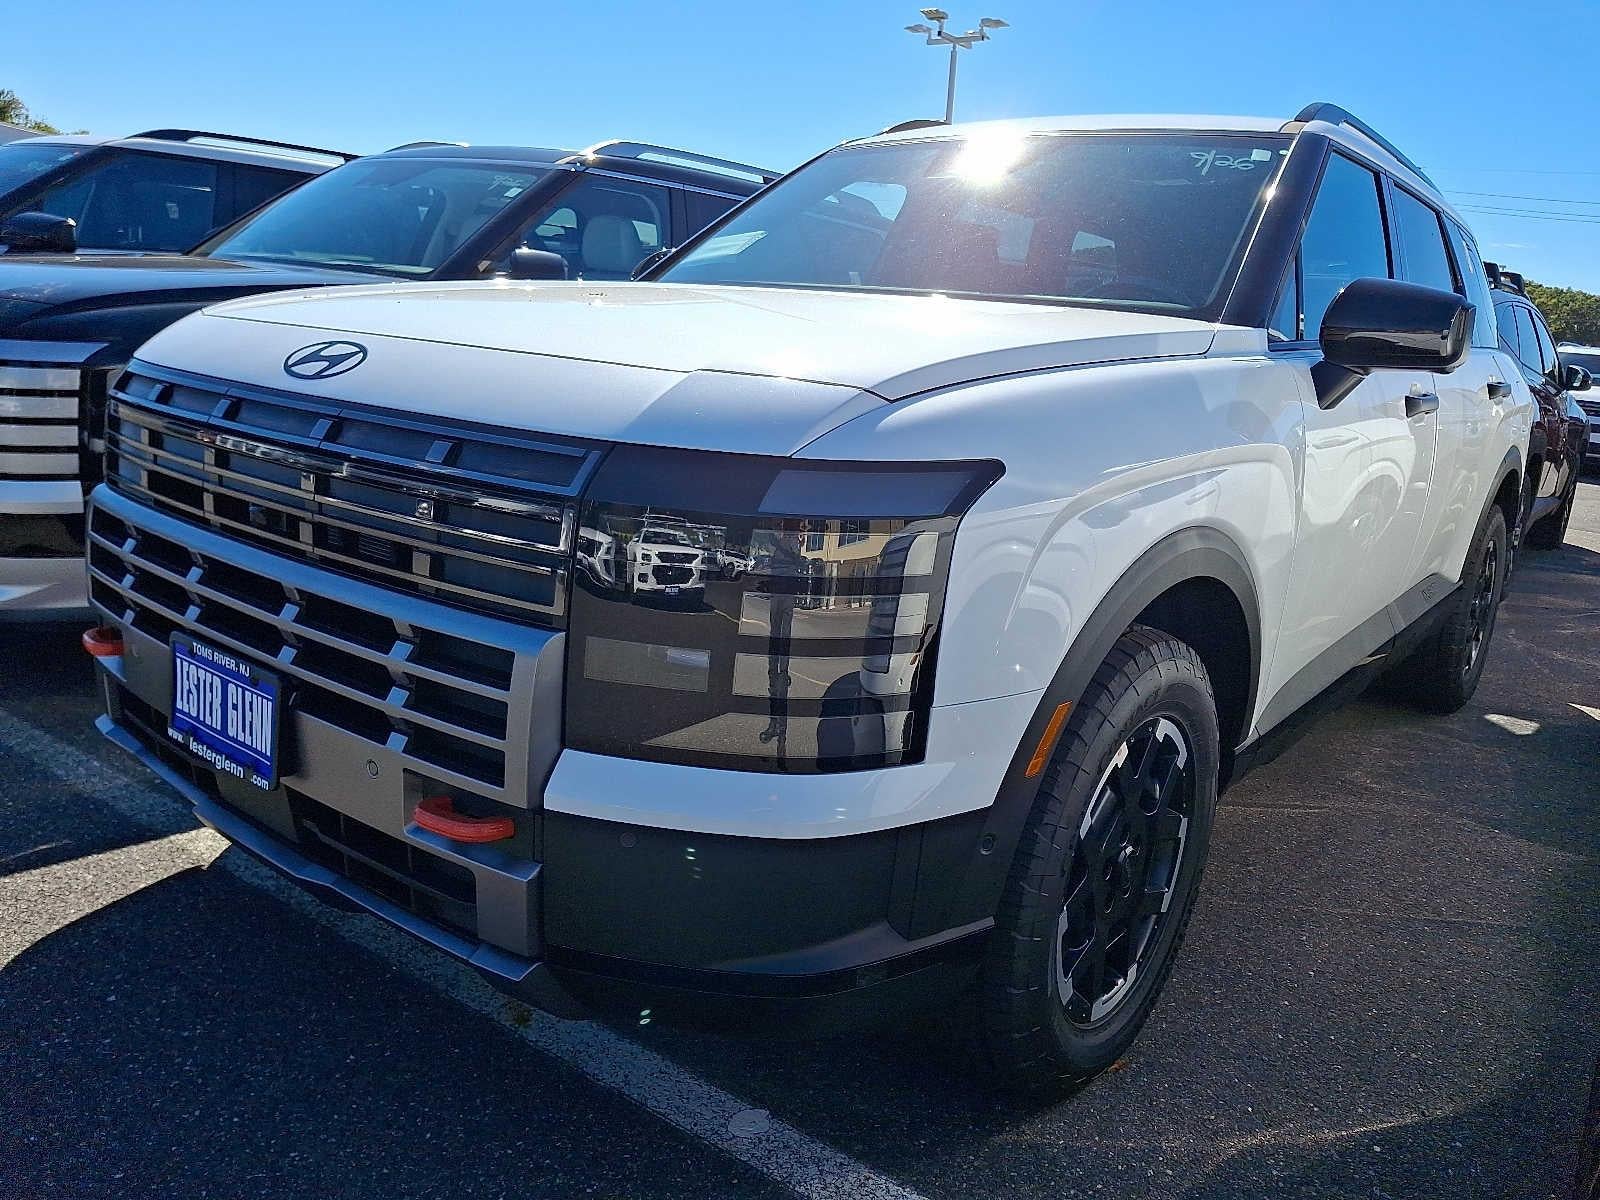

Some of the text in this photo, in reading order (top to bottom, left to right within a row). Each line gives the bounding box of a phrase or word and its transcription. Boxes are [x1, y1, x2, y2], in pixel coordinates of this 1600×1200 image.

[192, 641, 250, 677] TOMS RIVER, NJ
[176, 658, 272, 758] LESTER GLENN
[189, 736, 244, 778] lesterglenn
